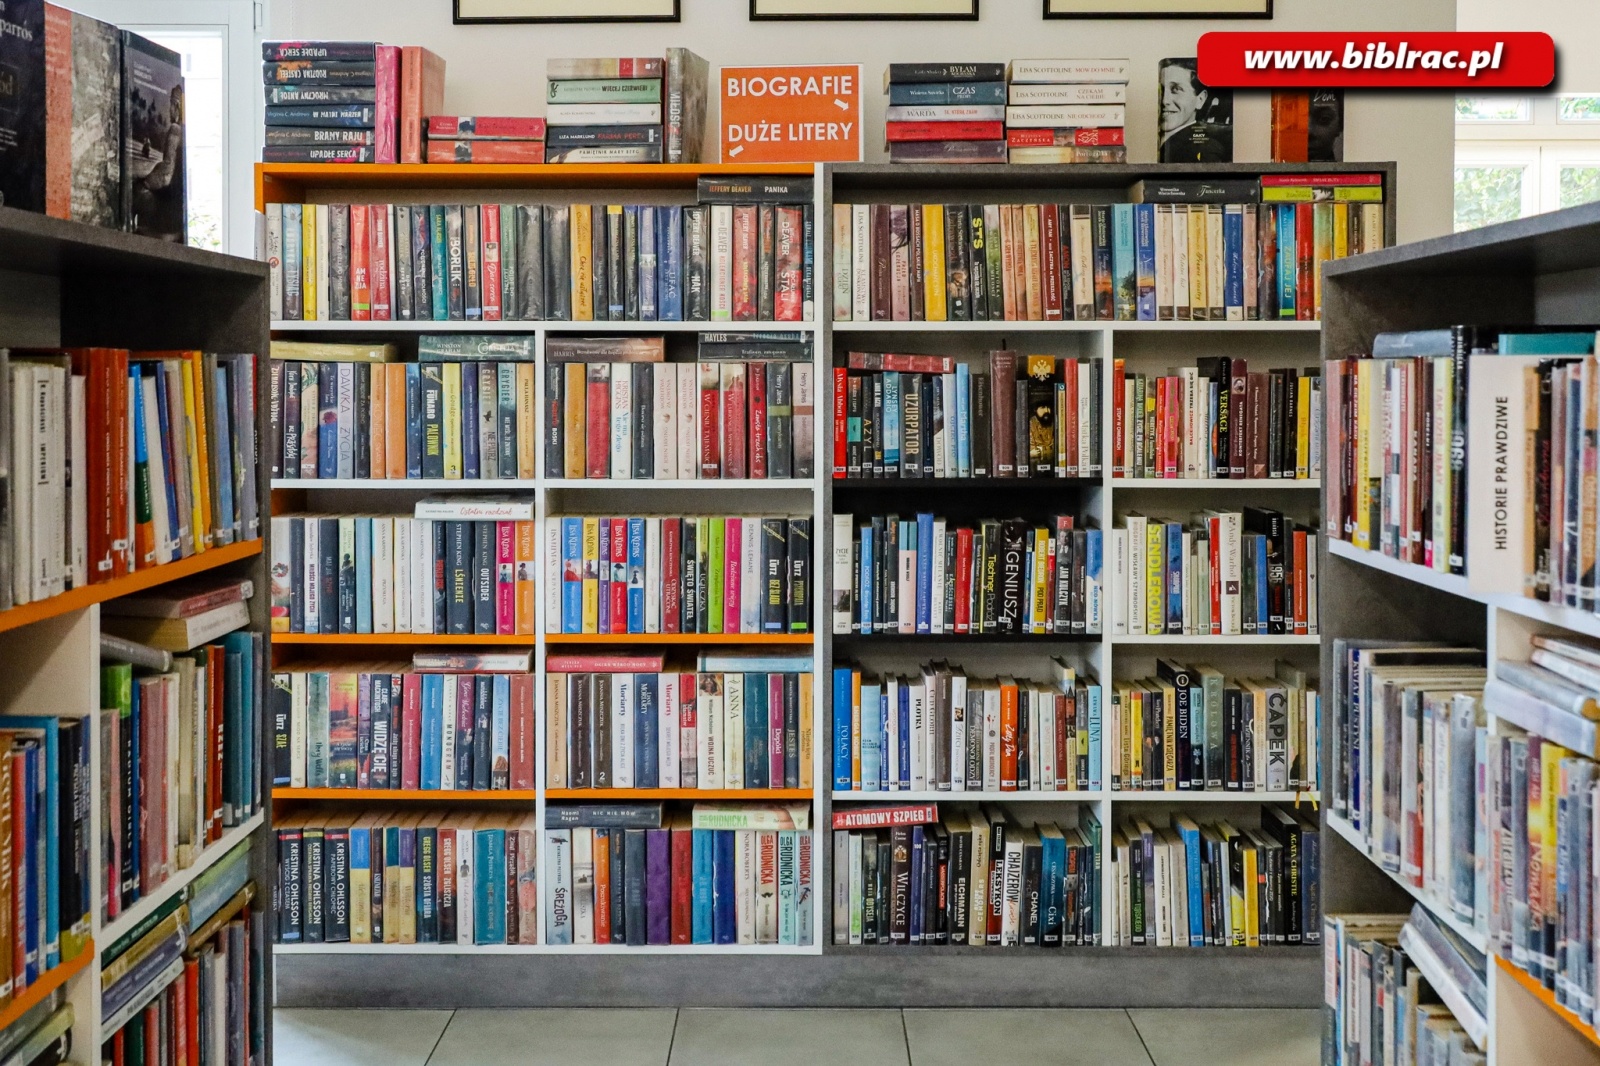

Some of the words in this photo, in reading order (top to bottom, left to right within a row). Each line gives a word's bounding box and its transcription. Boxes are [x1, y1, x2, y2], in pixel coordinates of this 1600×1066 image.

[727, 76, 852, 96] BIOGRAFIE
[314, 131, 340, 140] BRAMY
[342, 131, 363, 140] RAJU
[728, 120, 782, 142] DUŻE
[788, 122, 853, 142] LITERY
[336, 150, 357, 158] SERCA
[764, 185, 788, 193] PANIKA
[781, 221, 790, 256] DEAVER
[973, 218, 982, 250] STS
[340, 368, 351, 413] DAWKA
[427, 390, 436, 419] FUNARO
[905, 394, 919, 454] UZURPATOR
[1220, 390, 1228, 432] VERSACE
[340, 427, 351, 462] ŻYCIA
[864, 419, 872, 452] AZYL
[1494, 396, 1508, 482] PRAWDZIWE
[1494, 488, 1508, 550] HISTORIE
[455, 569, 465, 602] LŚNIENIE
[480, 568, 489, 601] OUTSIDER
[685, 560, 695, 586] ŚWIĘTO
[1004, 551, 1020, 618] GENIUSZ
[1058, 566, 1068, 579] JAN
[686, 588, 695, 620] ŚWIATEŁ
[1058, 580, 1068, 606] KULCZYK
[619, 684, 627, 716] Moriarty
[664, 684, 672, 716] Moriarty
[730, 686, 739, 720] ANNA
[1178, 689, 1187, 706] JOE
[372, 721, 387, 754] WIDZĘ
[787, 729, 796, 758] JESTEŚ
[1090, 717, 1100, 742] LUNA
[1269, 693, 1288, 766] ČAPEK
[372, 755, 387, 772] CIĘ
[446, 724, 455, 770] MONOGRAM
[846, 811, 890, 826] ATOMOWY
[894, 810, 924, 823] SZPIEG
[290, 843, 298, 880] KRISTINA
[313, 842, 321, 880] KRISTINA
[336, 842, 344, 880] KRISTINA
[444, 838, 452, 856] GREGG
[444, 857, 452, 874] OLSEN
[761, 845, 774, 884] RUDNICKA
[780, 846, 793, 886] RUDNICKA
[800, 845, 810, 886] RUDNICKA
[313, 883, 321, 924] OHLSSON
[336, 883, 344, 924] OHLSSON
[444, 878, 452, 908] ZGLISZCZA
[896, 872, 908, 926] WILCZYCE
[958, 878, 966, 927] EICHMANN
[994, 860, 1004, 914] LEKSYKON
[290, 884, 298, 924] OHLSSON
[554, 888, 568, 928] ŚREŻOGA
[1030, 891, 1038, 926] CHANEL
[1048, 906, 1056, 925] Cixi
